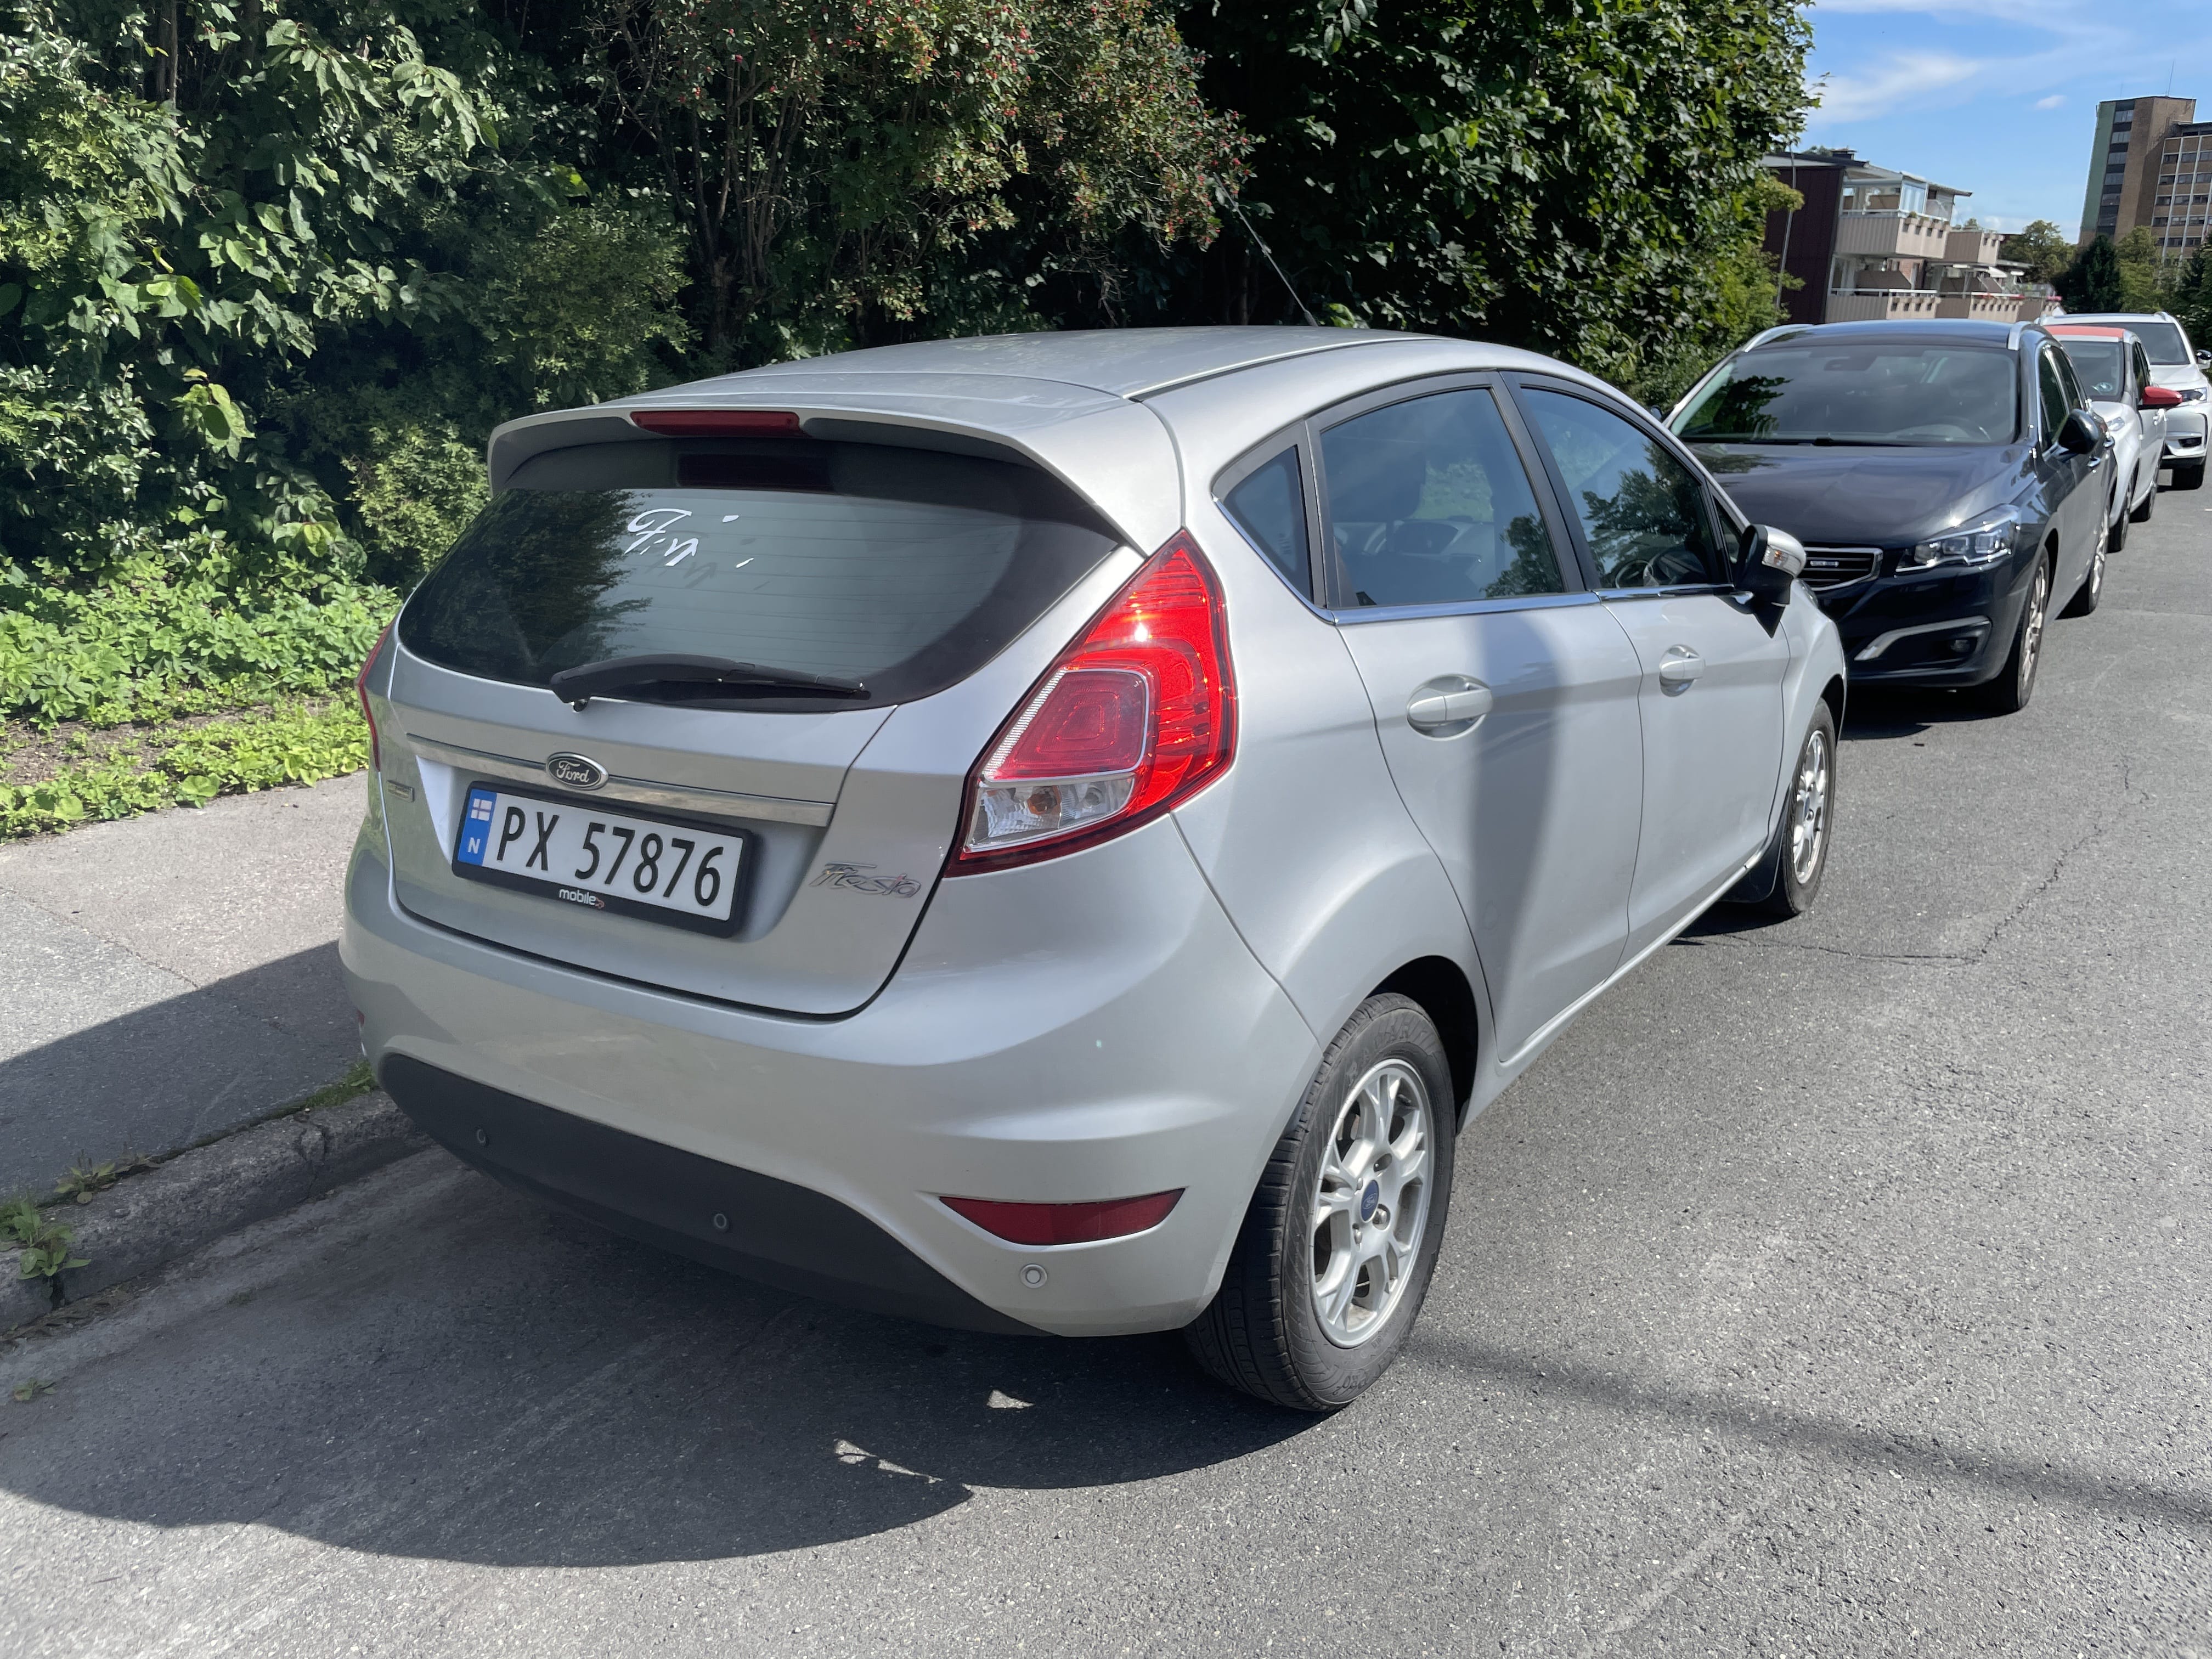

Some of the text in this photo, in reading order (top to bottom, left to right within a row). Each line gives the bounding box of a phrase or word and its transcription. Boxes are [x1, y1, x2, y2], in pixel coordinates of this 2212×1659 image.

[556, 760, 590, 783] Ford
[467, 837, 481, 855] N
[496, 806, 724, 907] PX 57876
